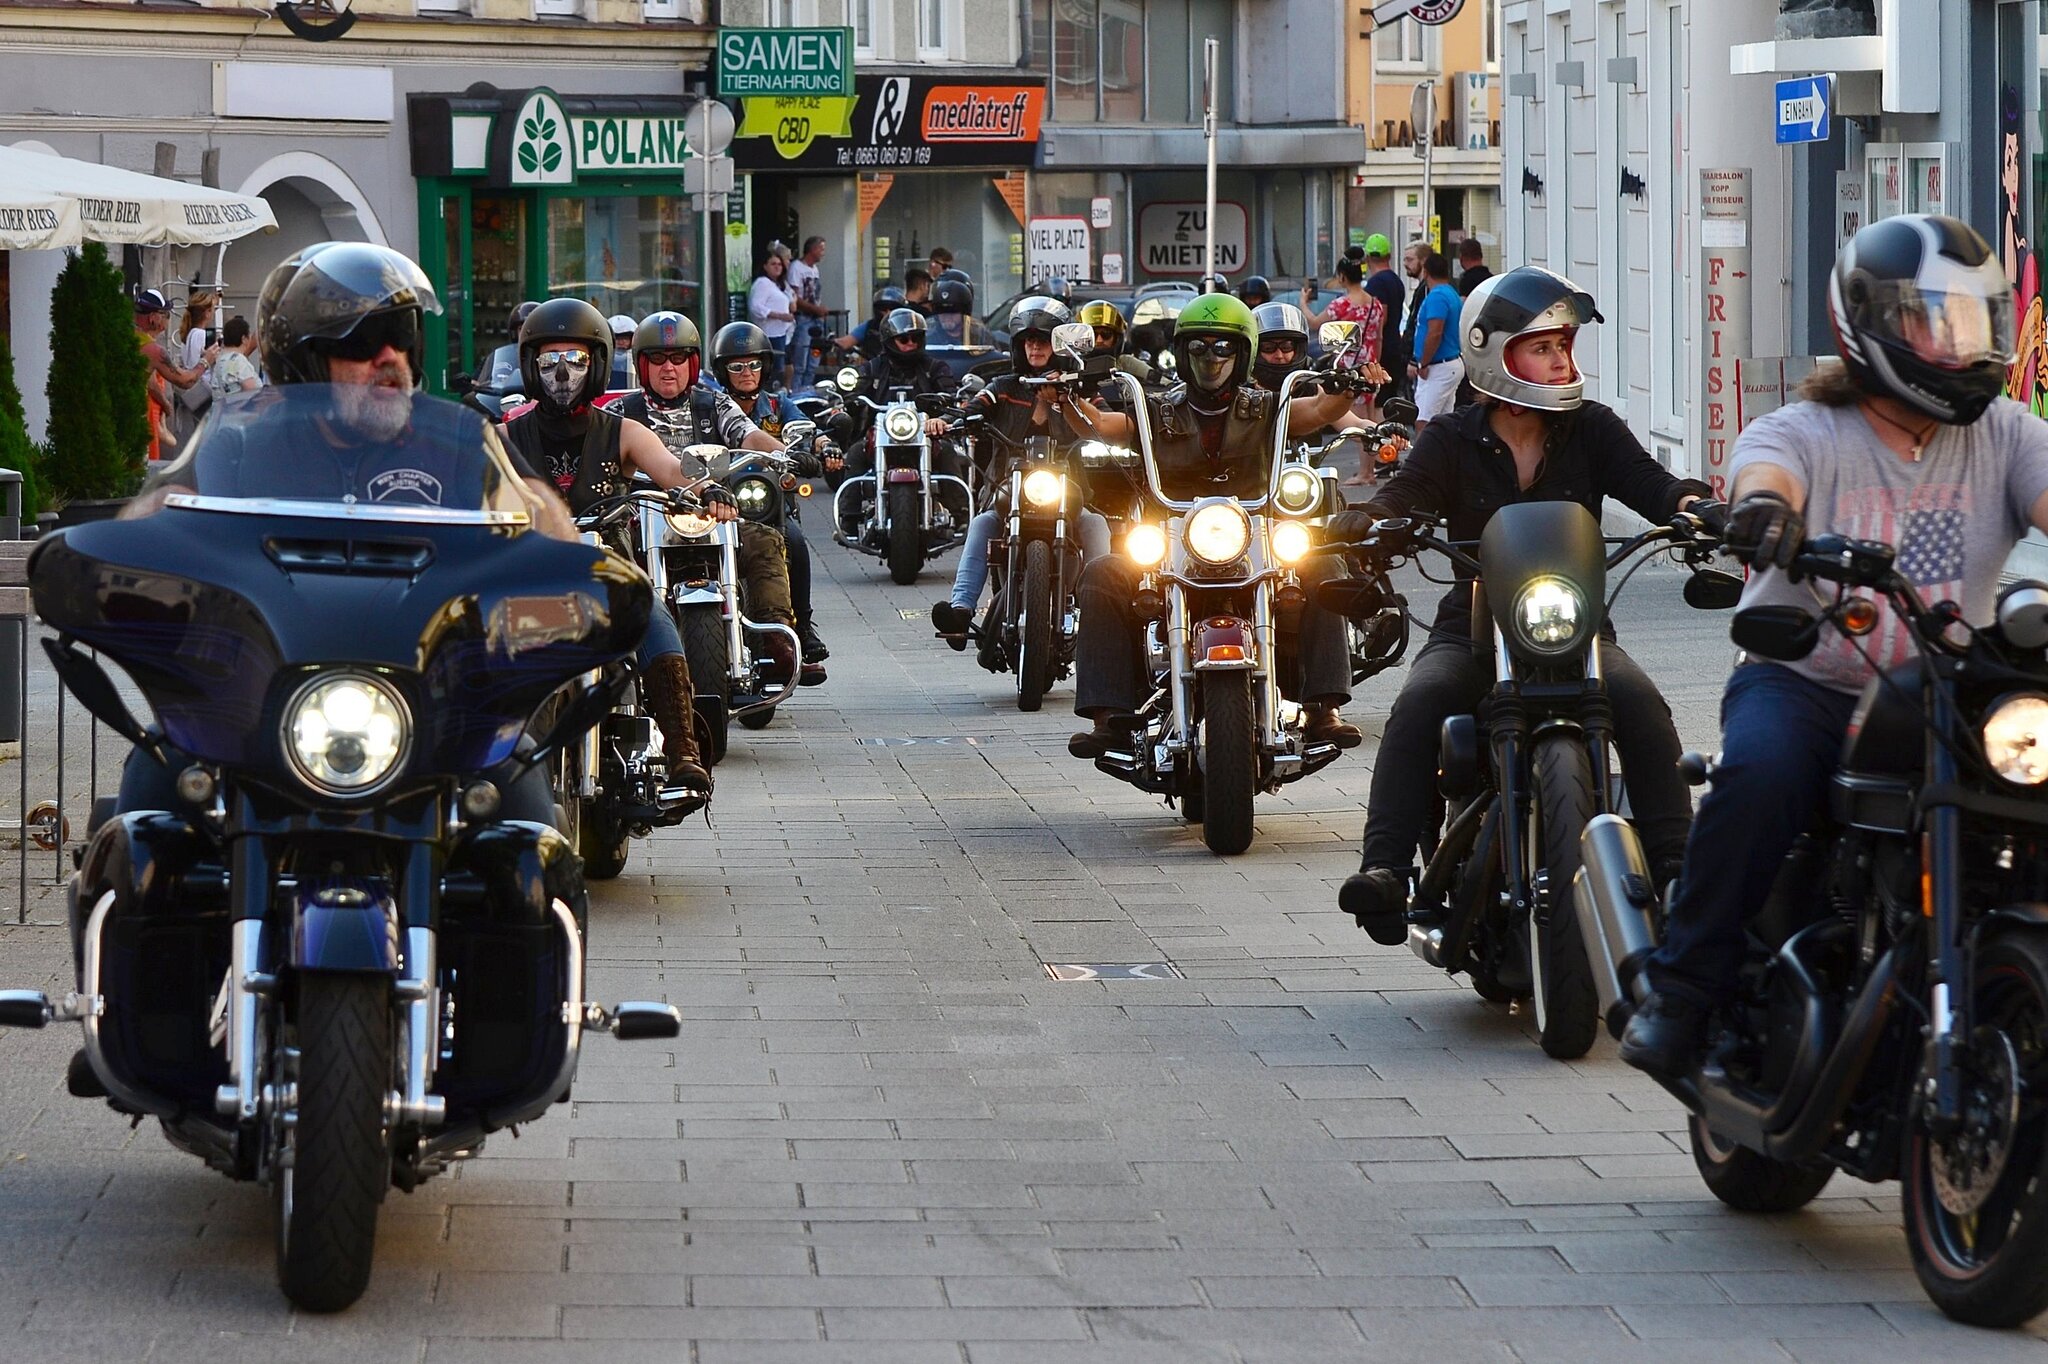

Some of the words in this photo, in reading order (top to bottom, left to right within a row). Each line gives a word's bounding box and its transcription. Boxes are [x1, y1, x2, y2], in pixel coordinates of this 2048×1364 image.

[723, 34, 841, 71] SAMEN
[724, 74, 841, 90] TIERNAHRUNG
[774, 97, 797, 109] HAPPY
[799, 97, 821, 109] PLACE
[1785, 100, 1814, 121] EINBAHN
[777, 116, 810, 145] CBD
[836, 147, 853, 165] Tel:
[854, 147, 878, 165] 0663
[880, 147, 898, 164] 060
[899, 147, 912, 164] 50
[914, 146, 932, 164] 169
[1702, 172, 1744, 180] HAARSALON
[1712, 196, 1744, 204] FRISEUR
[27, 208, 60, 231] BIER
[115, 200, 143, 225] BIER
[183, 204, 225, 226] RIEDER
[220, 203, 257, 223] BIER
[1176, 211, 1207, 232] ZU
[1844, 211, 1859, 238] KOPP
[1030, 229, 1052, 250] VIEL
[1054, 229, 1086, 250] PLATZ
[1031, 260, 1051, 284] FÜR
[1707, 257, 1727, 503] FRISEUR
[1744, 384, 1779, 394] HAARSALON
